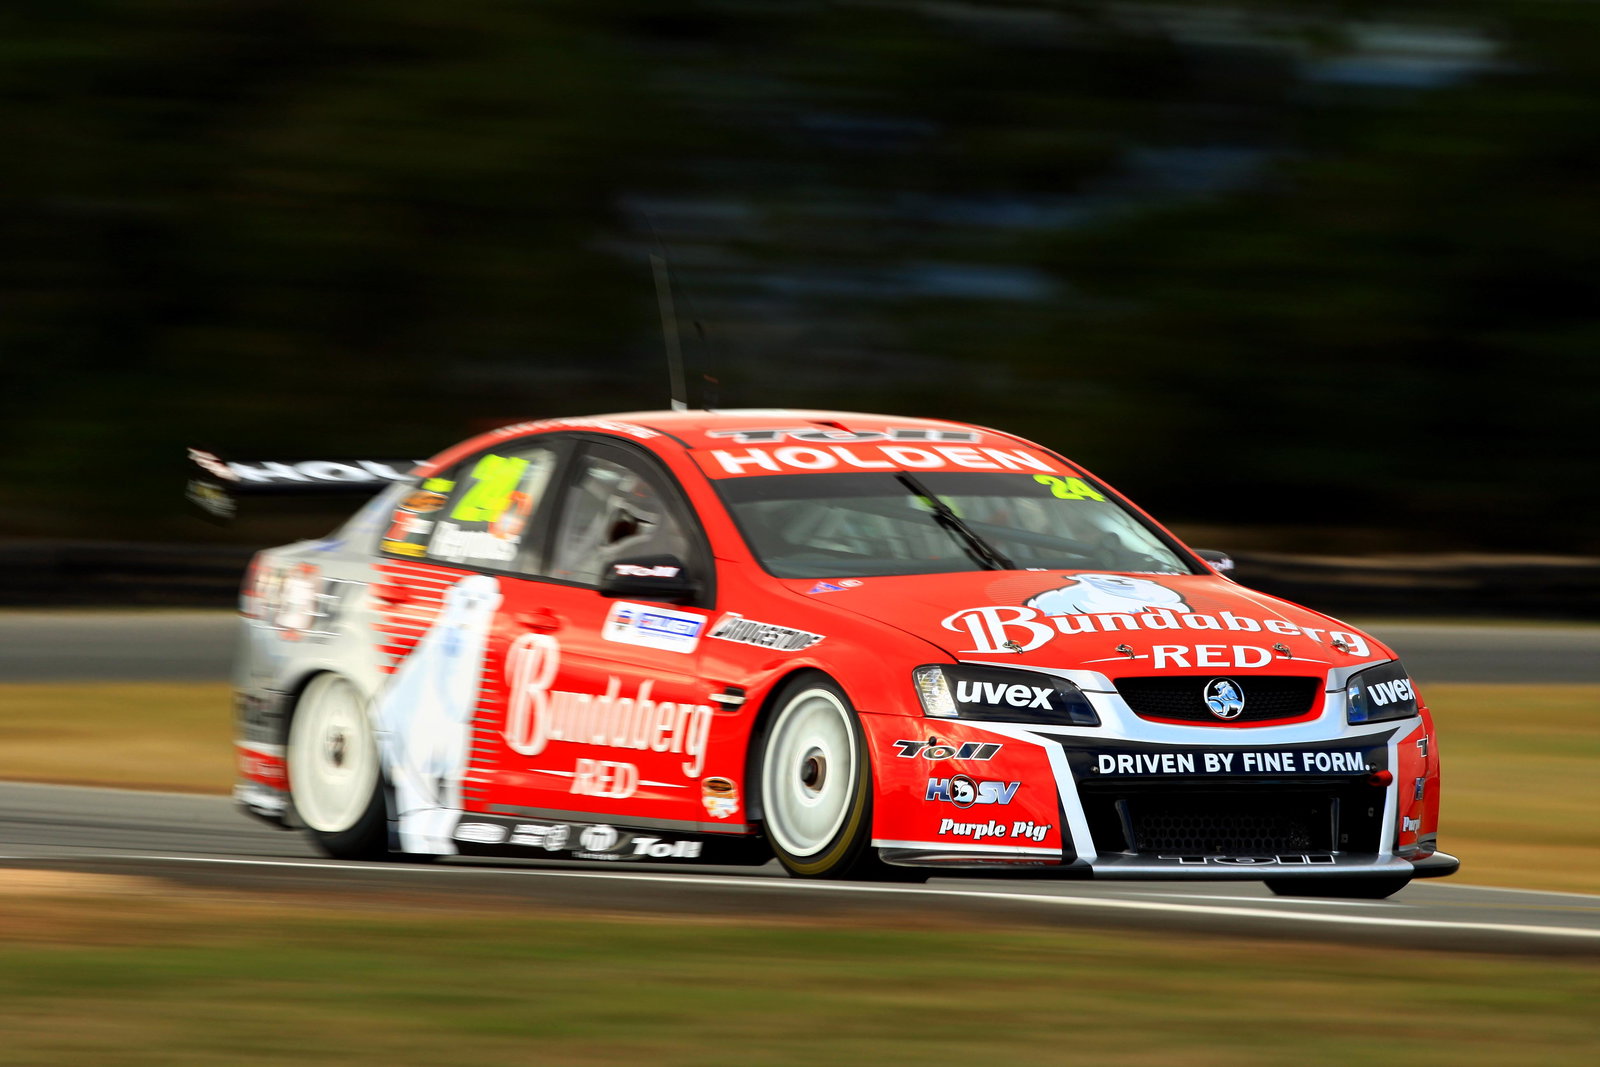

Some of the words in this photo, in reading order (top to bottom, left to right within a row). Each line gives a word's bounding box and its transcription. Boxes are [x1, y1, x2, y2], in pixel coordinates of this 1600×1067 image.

[711, 445, 1058, 475] HOLDEN
[1033, 474, 1107, 502] 24
[613, 563, 681, 578] Toll
[941, 604, 1371, 659] Bundaberg
[1152, 643, 1274, 670] RED
[503, 632, 714, 778] Bundaberg
[956, 680, 1054, 710] uvex
[893, 739, 1003, 761] Toll
[1097, 753, 1195, 774] DRIVEN
[1204, 753, 1234, 774] BY
[1243, 752, 1297, 773] FINE
[1303, 751, 1371, 773] FORM.
[568, 757, 639, 799] RED
[938, 818, 1006, 840] Purple
[631, 836, 703, 858] Toll
